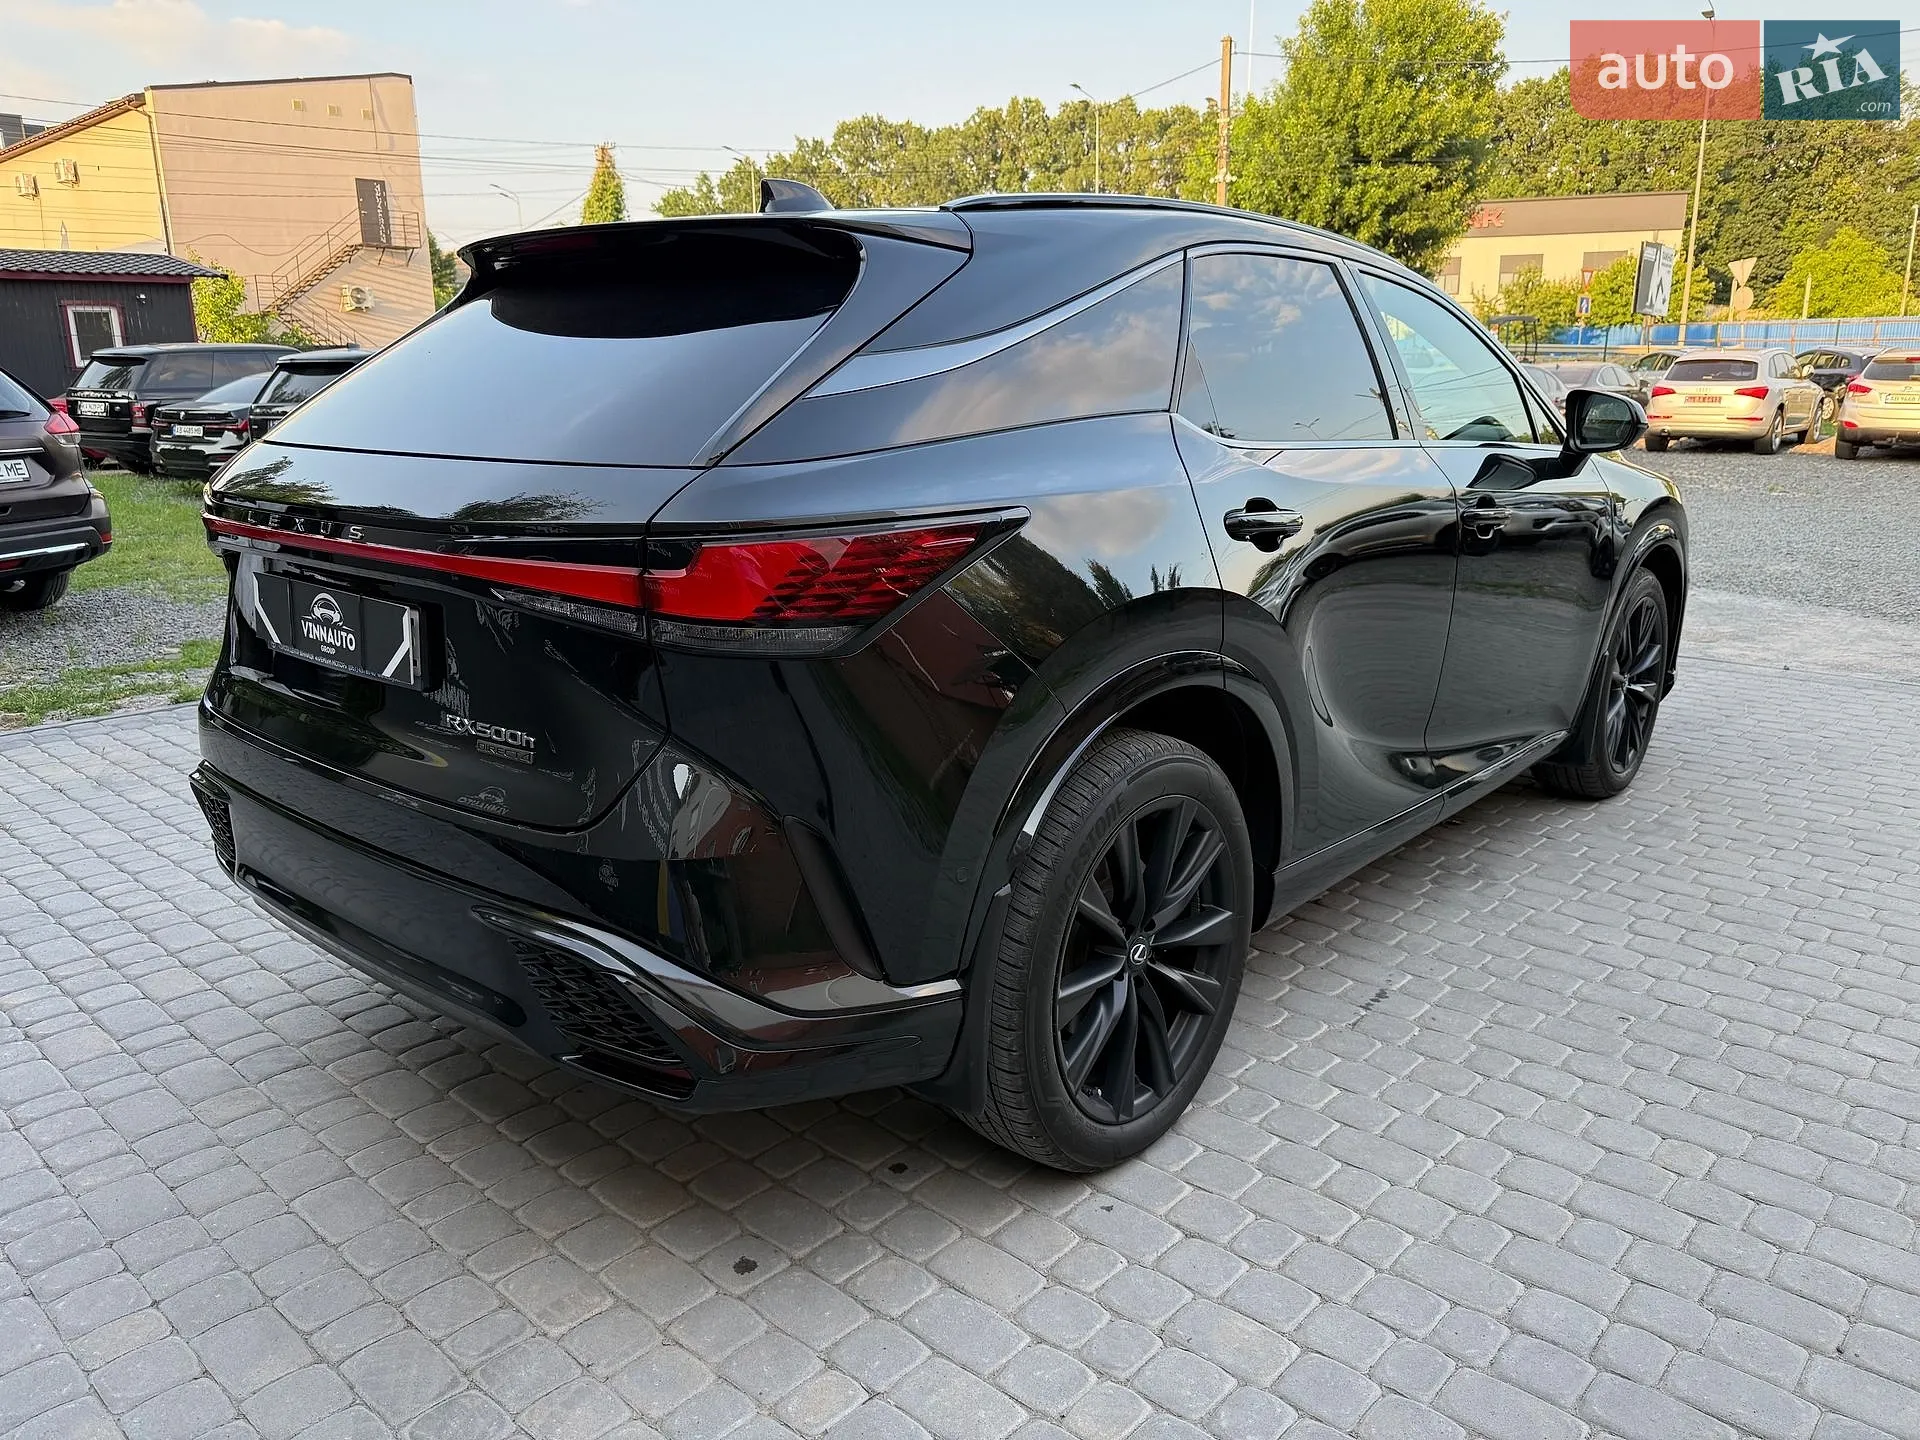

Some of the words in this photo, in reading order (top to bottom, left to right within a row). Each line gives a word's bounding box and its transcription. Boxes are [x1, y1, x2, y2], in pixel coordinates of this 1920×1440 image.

[4, 462, 26, 477] ME
[248, 510, 364, 539] LEXUS
[301, 619, 357, 652] VINNAUTO
[320, 644, 336, 656] GROUP
[446, 713, 536, 750] RX500h
